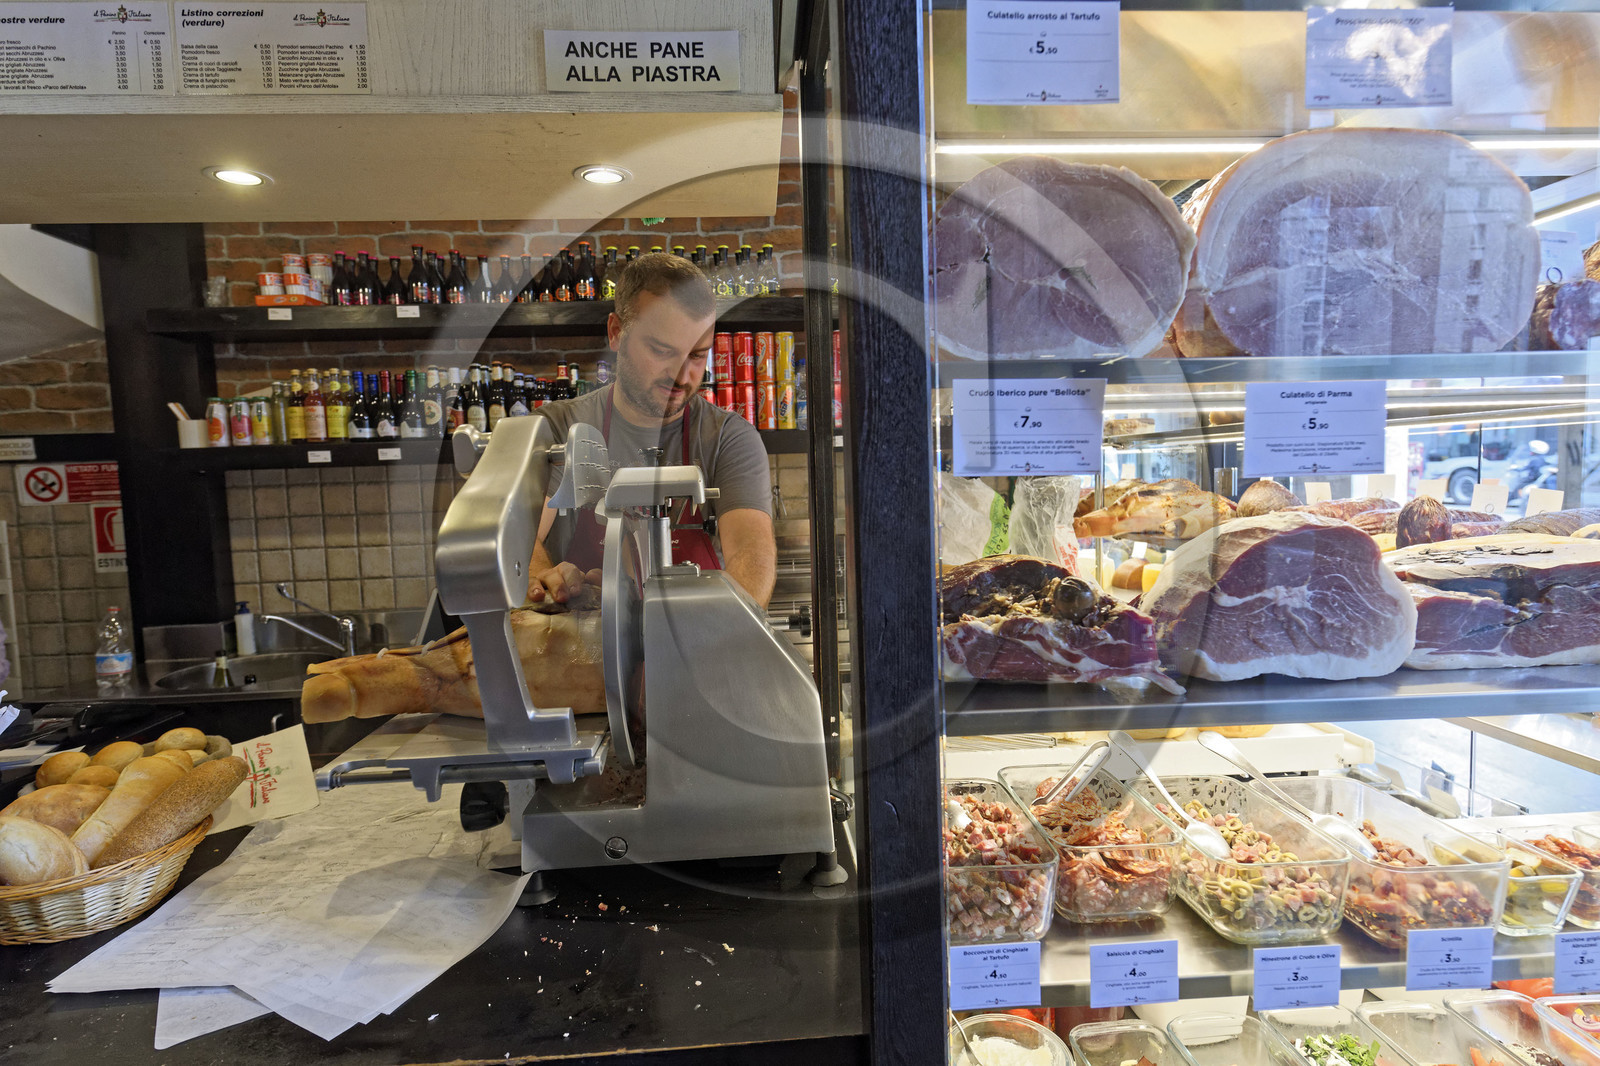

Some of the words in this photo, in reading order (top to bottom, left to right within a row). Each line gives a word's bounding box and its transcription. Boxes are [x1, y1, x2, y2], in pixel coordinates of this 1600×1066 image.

[988, 11, 1024, 20] Culatello
[1070, 12, 1100, 20] Tartufo
[182, 19, 224, 28] (verdure)
[564, 41, 638, 58] ANCHE
[650, 42, 704, 58] PANE
[566, 65, 622, 82] ALLA
[632, 66, 721, 82] PIASTRA
